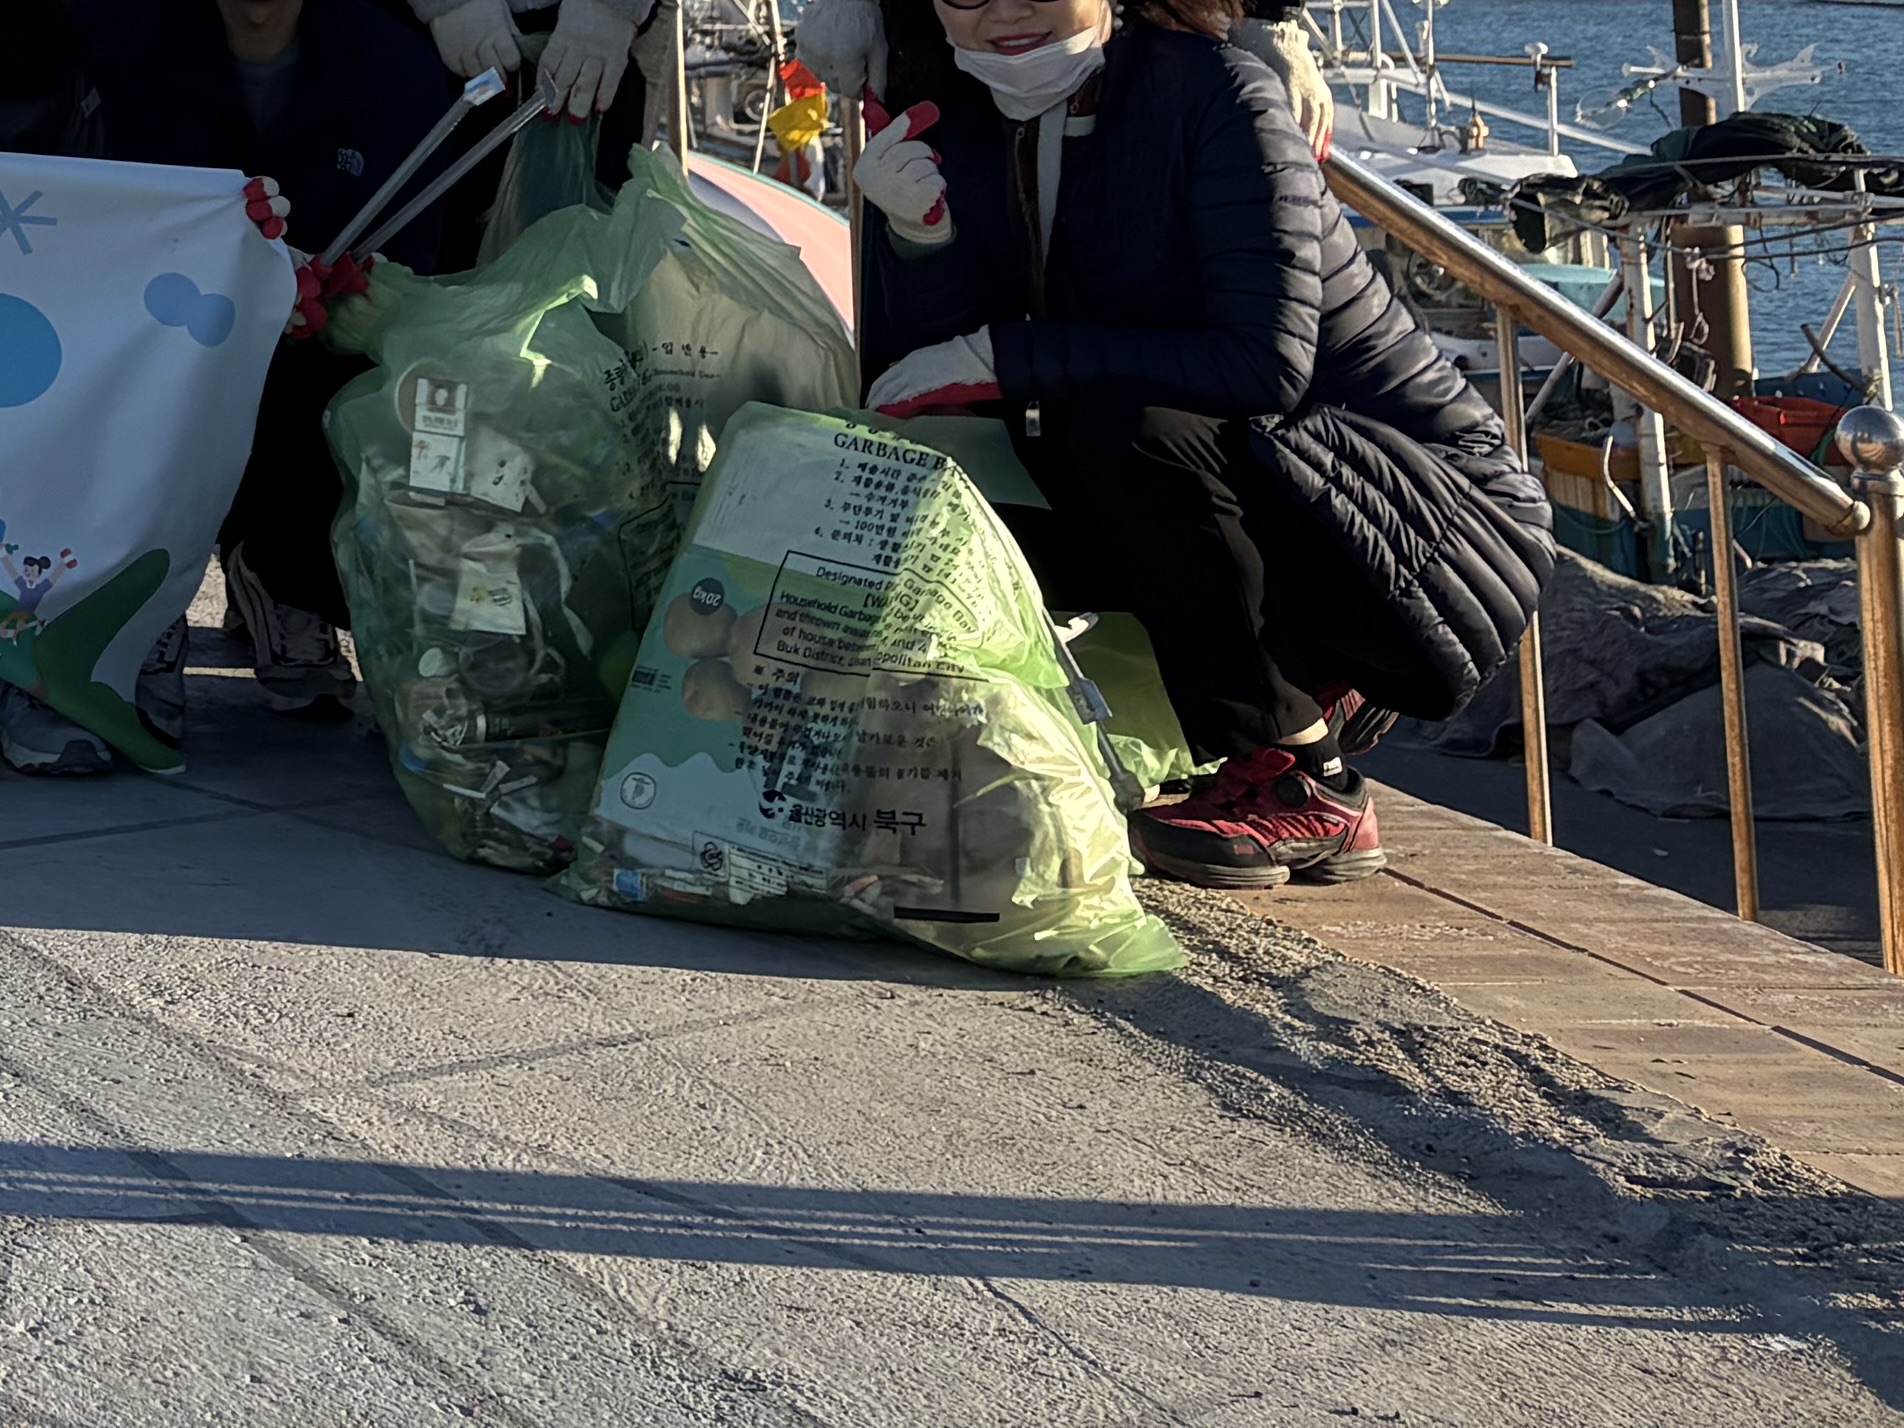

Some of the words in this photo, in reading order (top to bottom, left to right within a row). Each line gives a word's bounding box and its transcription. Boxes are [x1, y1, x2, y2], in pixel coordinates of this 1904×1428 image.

[834, 432, 930, 468] GARBAGE
[816, 566, 884, 592] Designated
[780, 590, 839, 615] Household
[776, 639, 801, 656] Buk
[788, 803, 868, 832] 울산광역시
[872, 807, 929, 837] 북구
